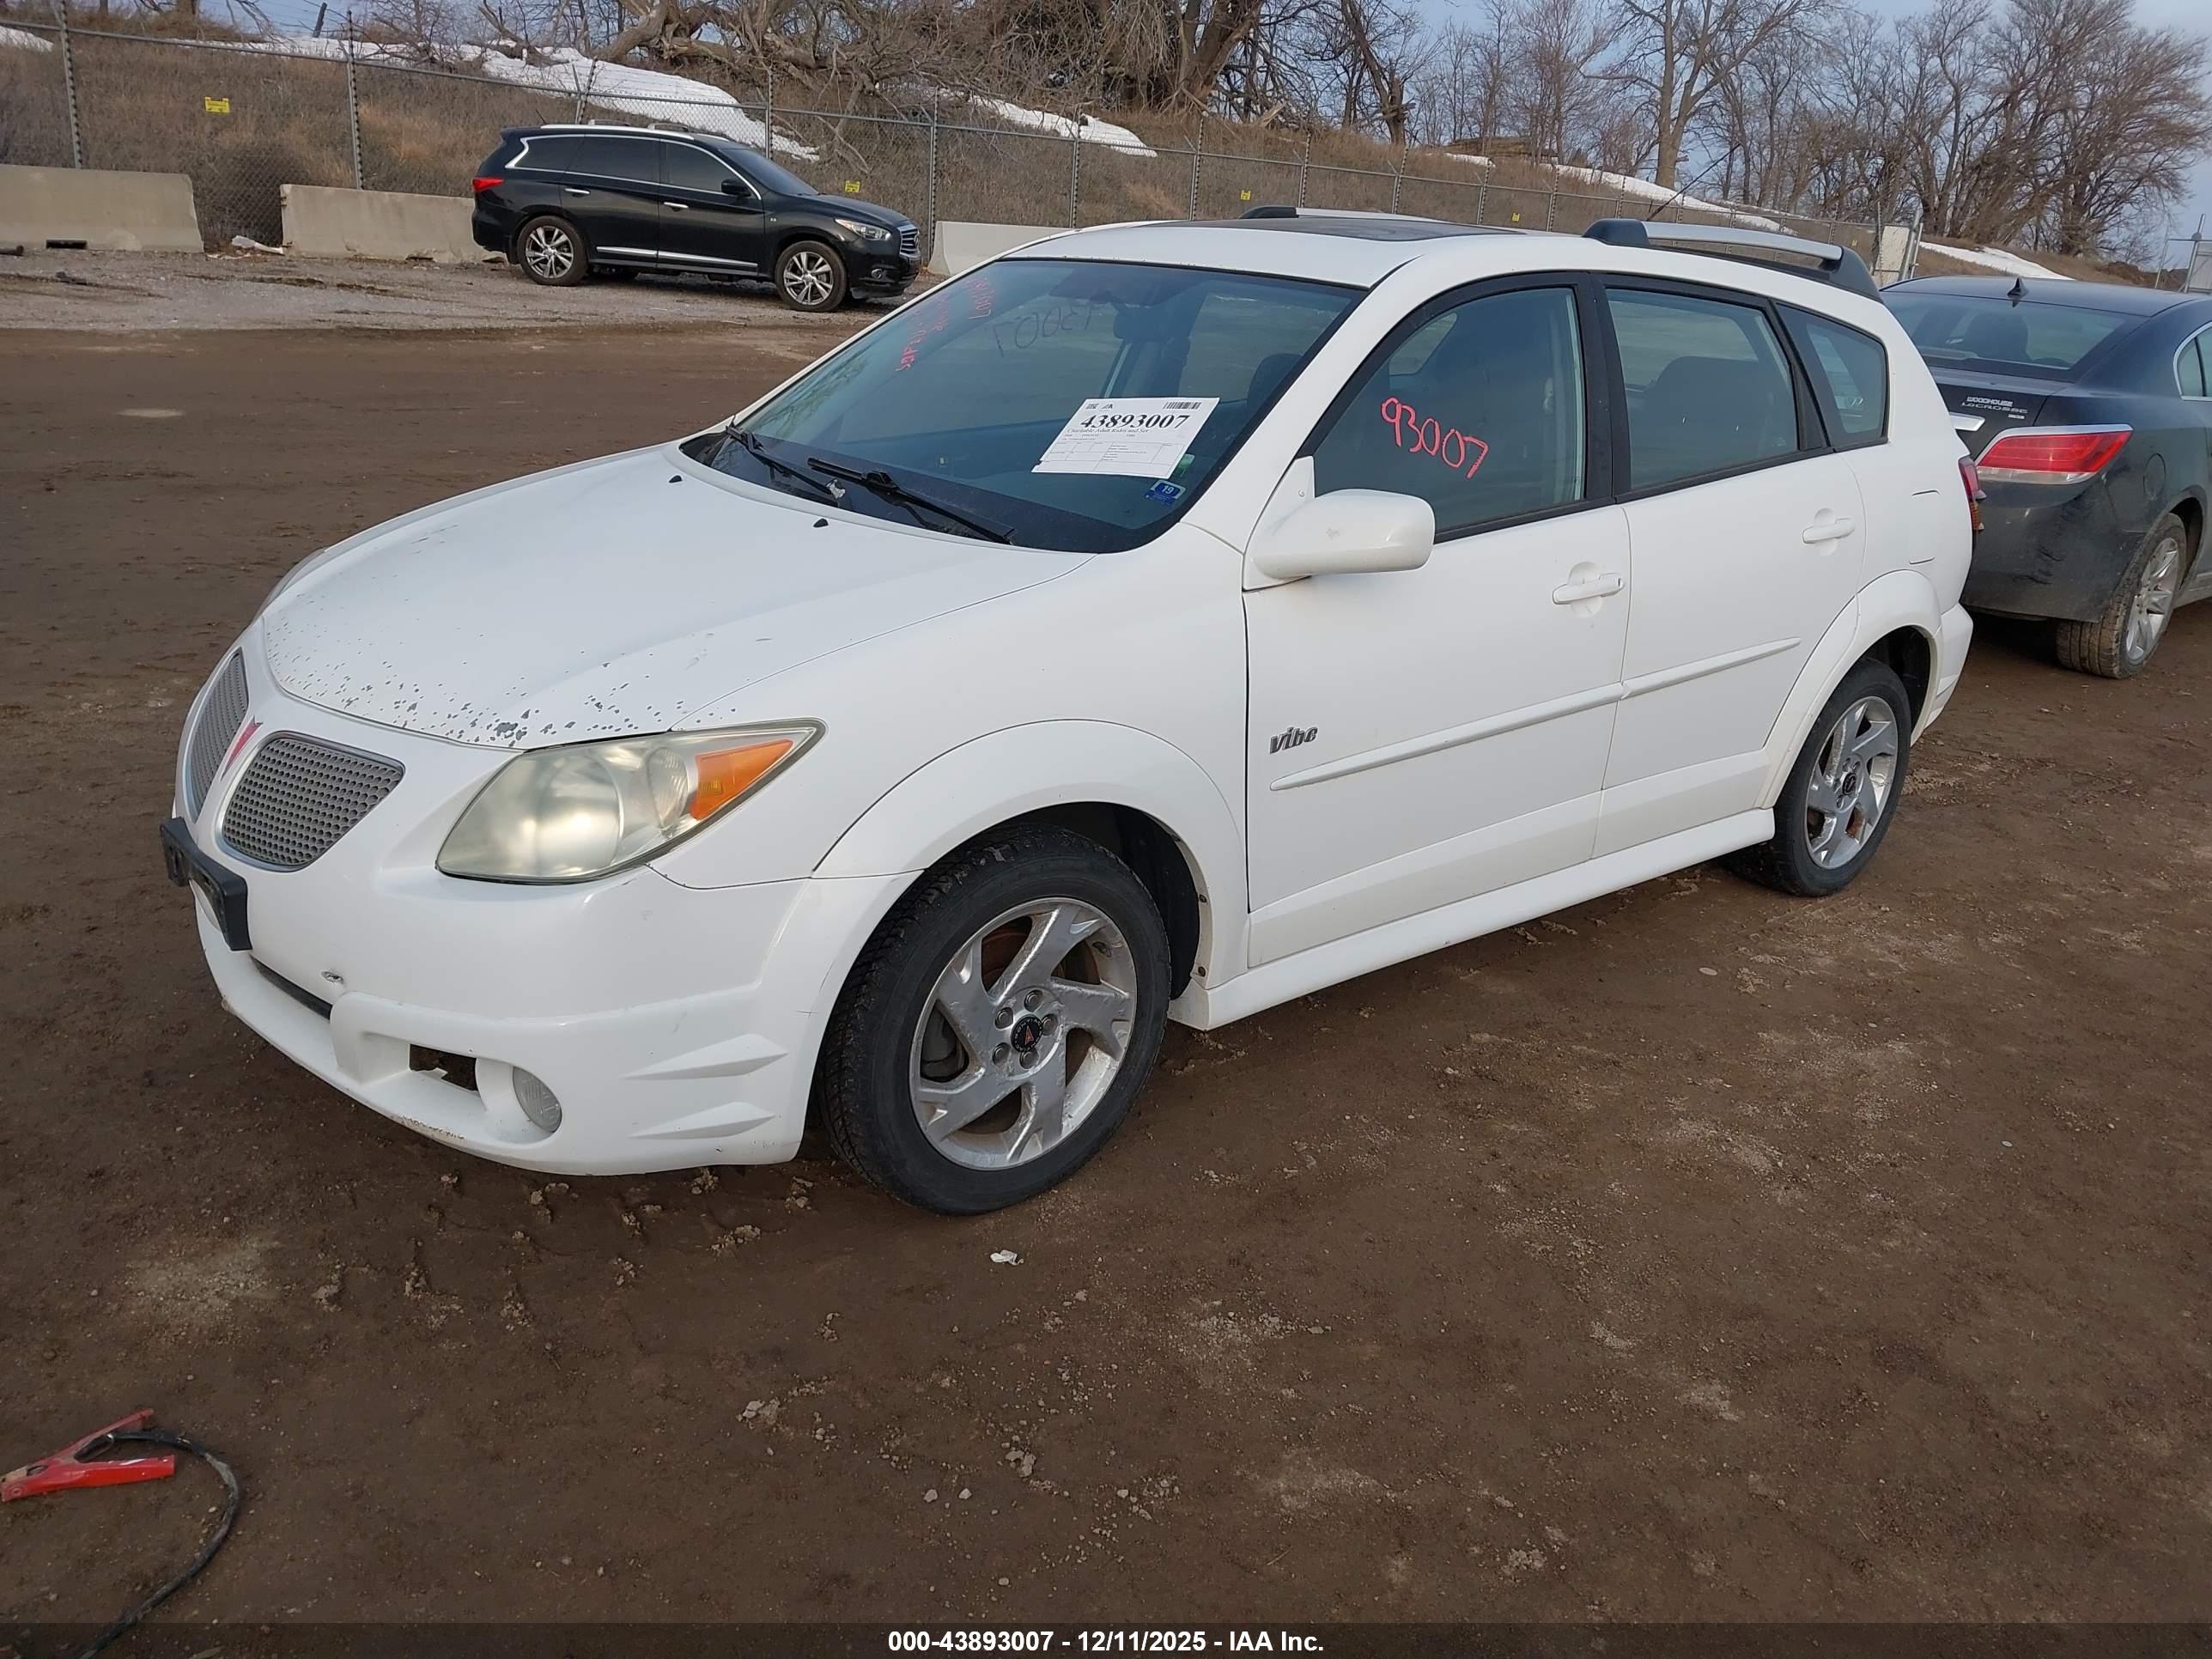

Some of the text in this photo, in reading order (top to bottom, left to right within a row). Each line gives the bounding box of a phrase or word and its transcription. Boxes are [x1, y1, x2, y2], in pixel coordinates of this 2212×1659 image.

[1966, 396, 2014, 407] WOODHOUSE
[1080, 414, 1190, 428] 43893007
[1381, 397, 1489, 479] 93007
[1162, 484, 1175, 495] 19
